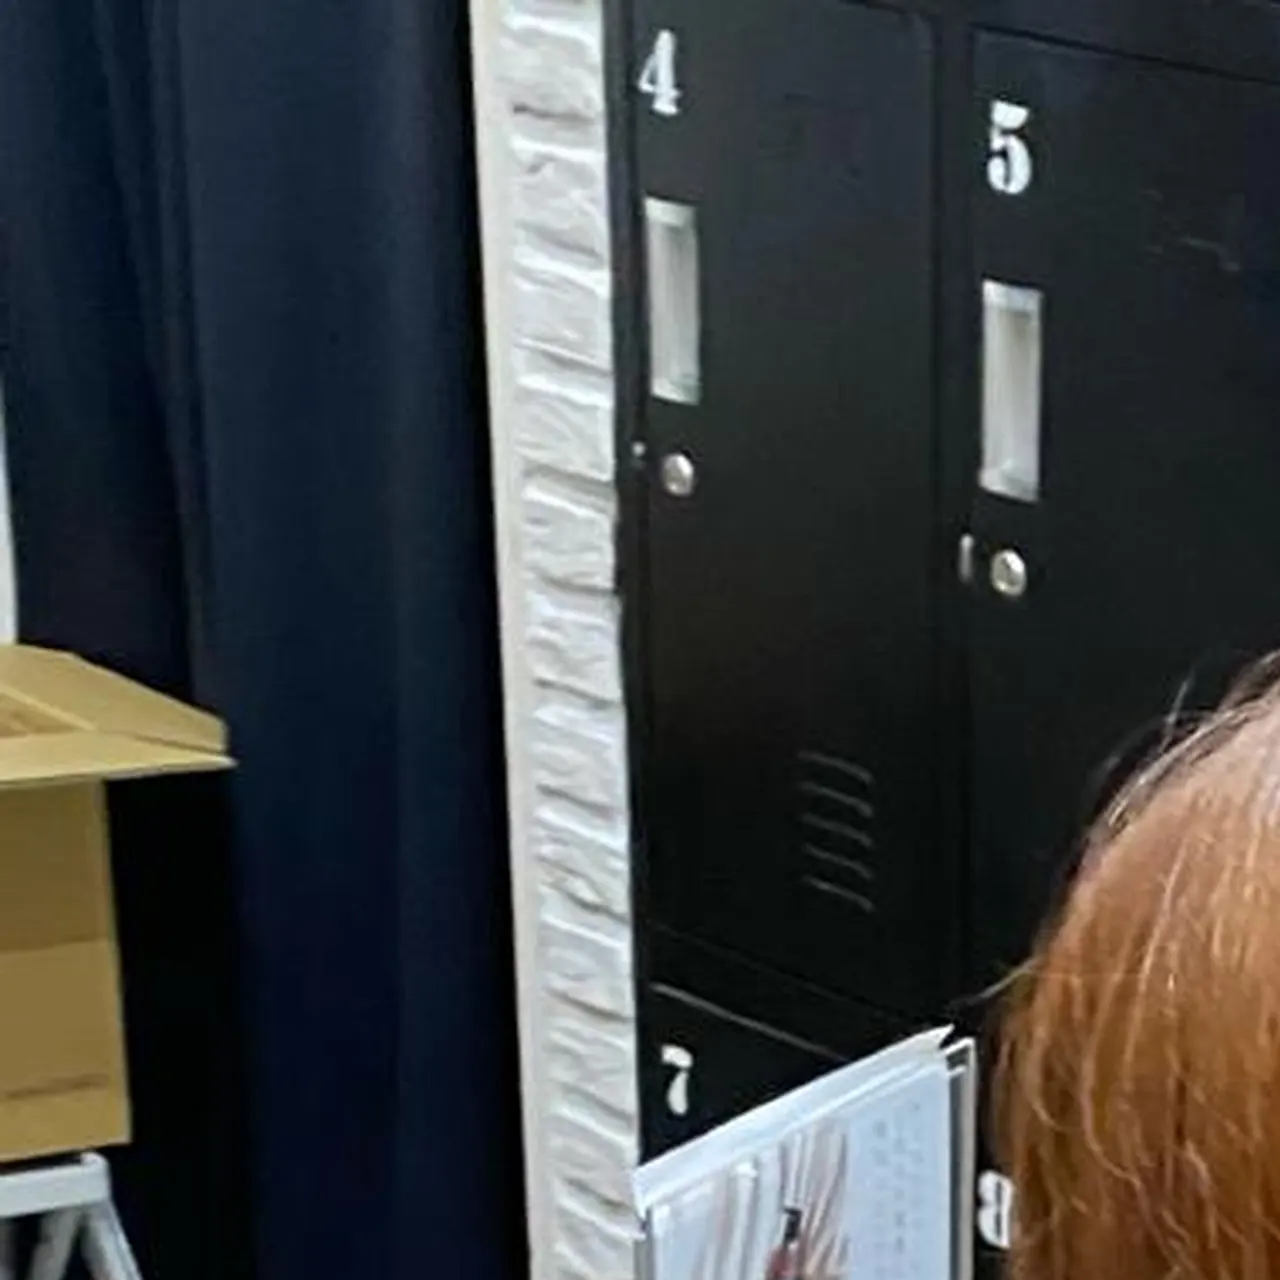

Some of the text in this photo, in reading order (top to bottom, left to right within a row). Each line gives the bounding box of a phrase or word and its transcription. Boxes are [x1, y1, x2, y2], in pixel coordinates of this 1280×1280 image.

[637, 28, 681, 116] 4
[986, 99, 1033, 194] 5
[662, 1044, 694, 1116] 7
